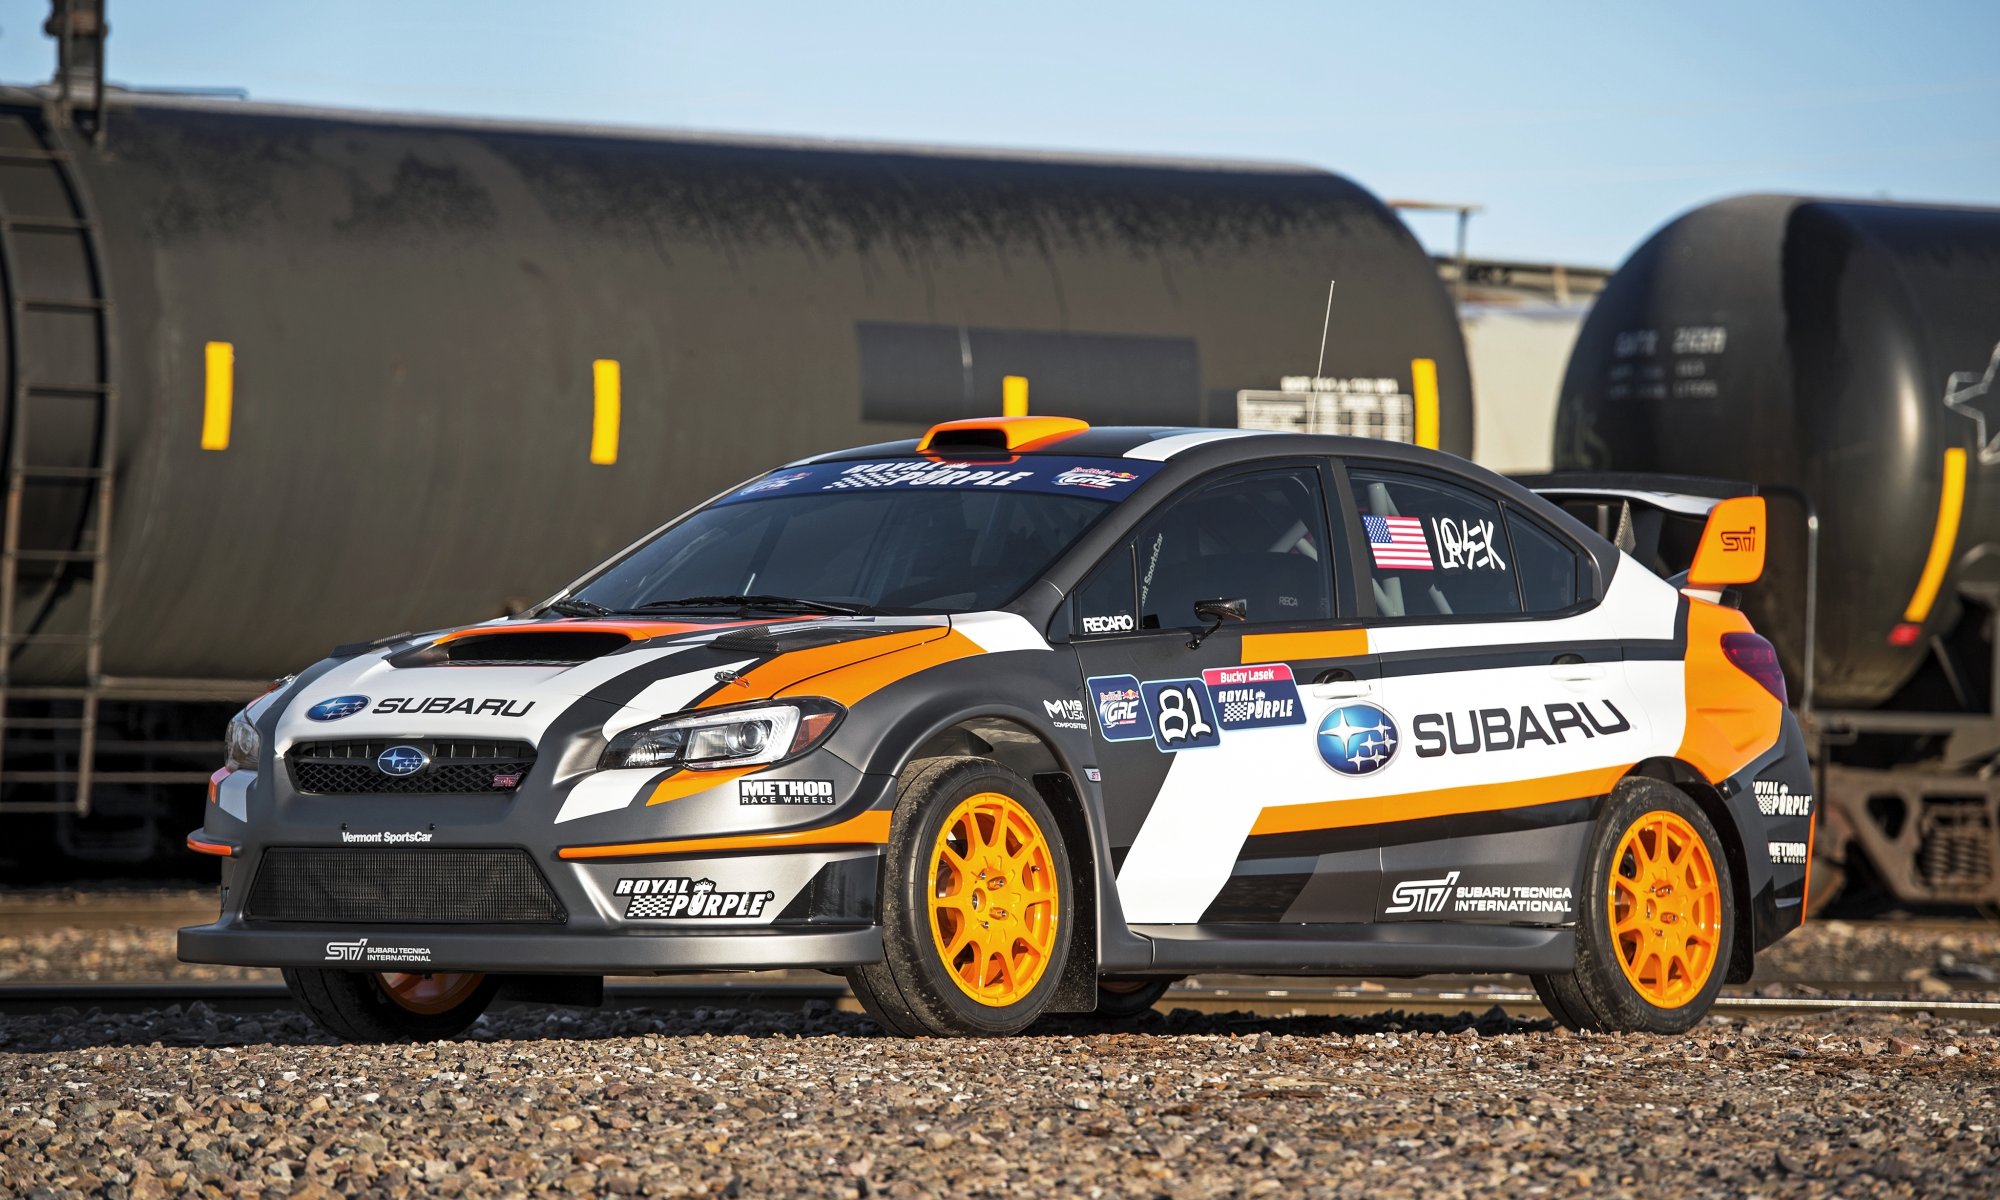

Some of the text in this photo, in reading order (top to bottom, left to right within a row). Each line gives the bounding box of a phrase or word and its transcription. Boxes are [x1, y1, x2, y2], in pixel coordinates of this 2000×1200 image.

[841, 462, 945, 475] ROYAL
[884, 471, 1034, 486] PURPLE
[1143, 532, 1163, 586] SportsCar
[1082, 614, 1134, 633] RECARO
[1220, 669, 1275, 684] Bucky Lasek
[1218, 689, 1255, 703] ROYAL
[372, 696, 536, 717] SUBARU
[1246, 698, 1294, 720] PURPLE
[1065, 710, 1086, 721] USA
[1159, 686, 1212, 743] 81
[1053, 721, 1088, 730] COMPOSITES
[1412, 699, 1631, 759] SUBARU
[741, 781, 833, 796] METHOD
[741, 796, 834, 804] RACE WHEELS
[1771, 794, 1810, 816] PURPLE
[341, 831, 433, 844] Vermont SportsCar
[615, 879, 689, 895] ROYAL
[1456, 886, 1511, 898] SUBARU
[1513, 887, 1573, 899] TECNICA
[669, 893, 768, 918] PURPLE
[1454, 900, 1572, 912] INTERNATIONAL
[366, 954, 432, 962] INTERNATIONAL
[398, 947, 431, 955] TECNICA
